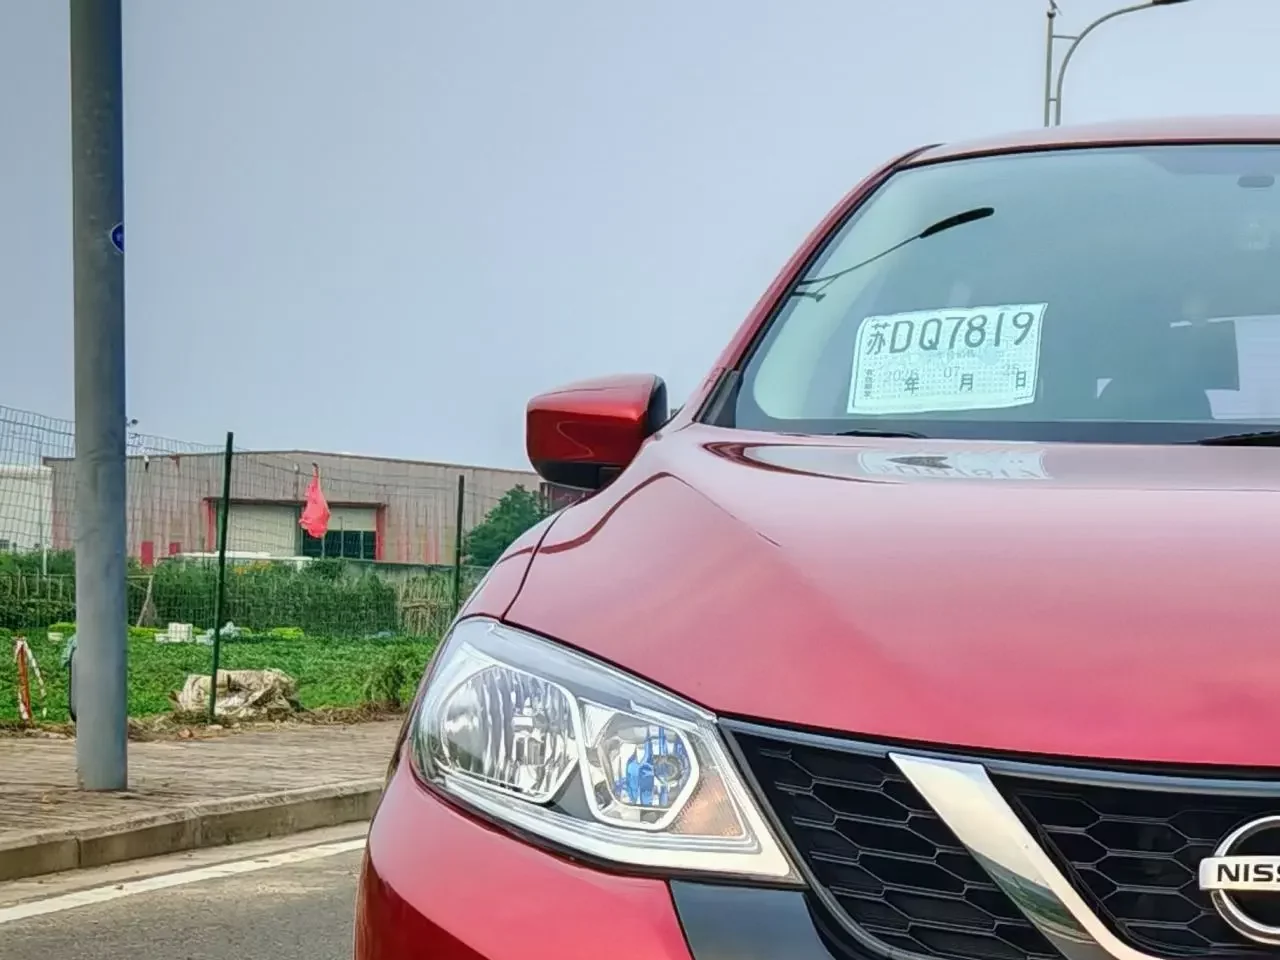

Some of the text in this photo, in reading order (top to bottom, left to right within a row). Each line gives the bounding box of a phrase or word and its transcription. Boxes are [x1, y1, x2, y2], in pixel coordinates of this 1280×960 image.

[866, 311, 1035, 356] 苏DQ7819
[960, 373, 974, 391] 月
[1016, 370, 1027, 391] 日
